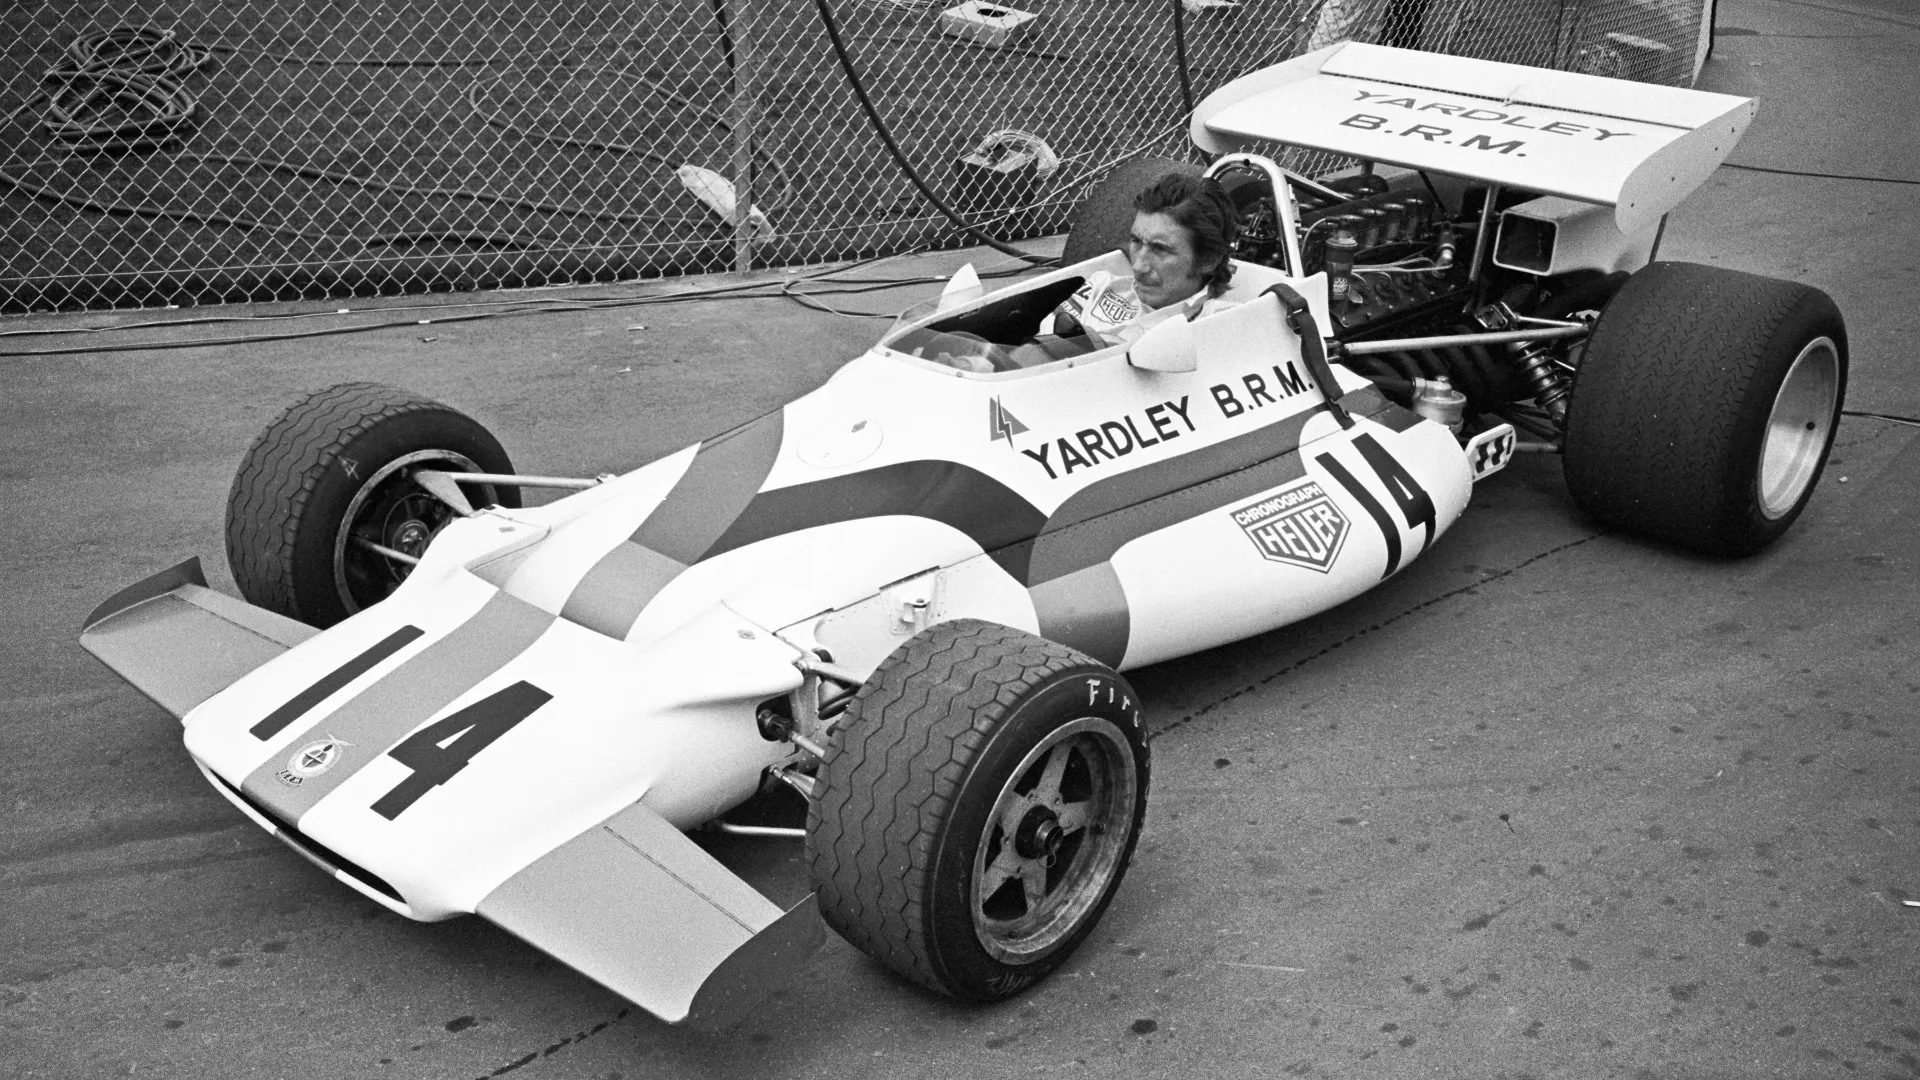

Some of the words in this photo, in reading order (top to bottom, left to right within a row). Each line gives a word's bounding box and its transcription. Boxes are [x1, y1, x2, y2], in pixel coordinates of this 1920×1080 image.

[1339, 113, 1528, 158] B.R.M.
[1353, 90, 1637, 141] YARDLEY
[1021, 395, 1197, 480] YARDLEY
[1210, 360, 1315, 419] B.R.M.
[1235, 484, 1324, 526] CHRONOGRAPH
[1256, 503, 1342, 562] HEUER
[1315, 432, 1436, 580] 14
[248, 624, 555, 822] 14
